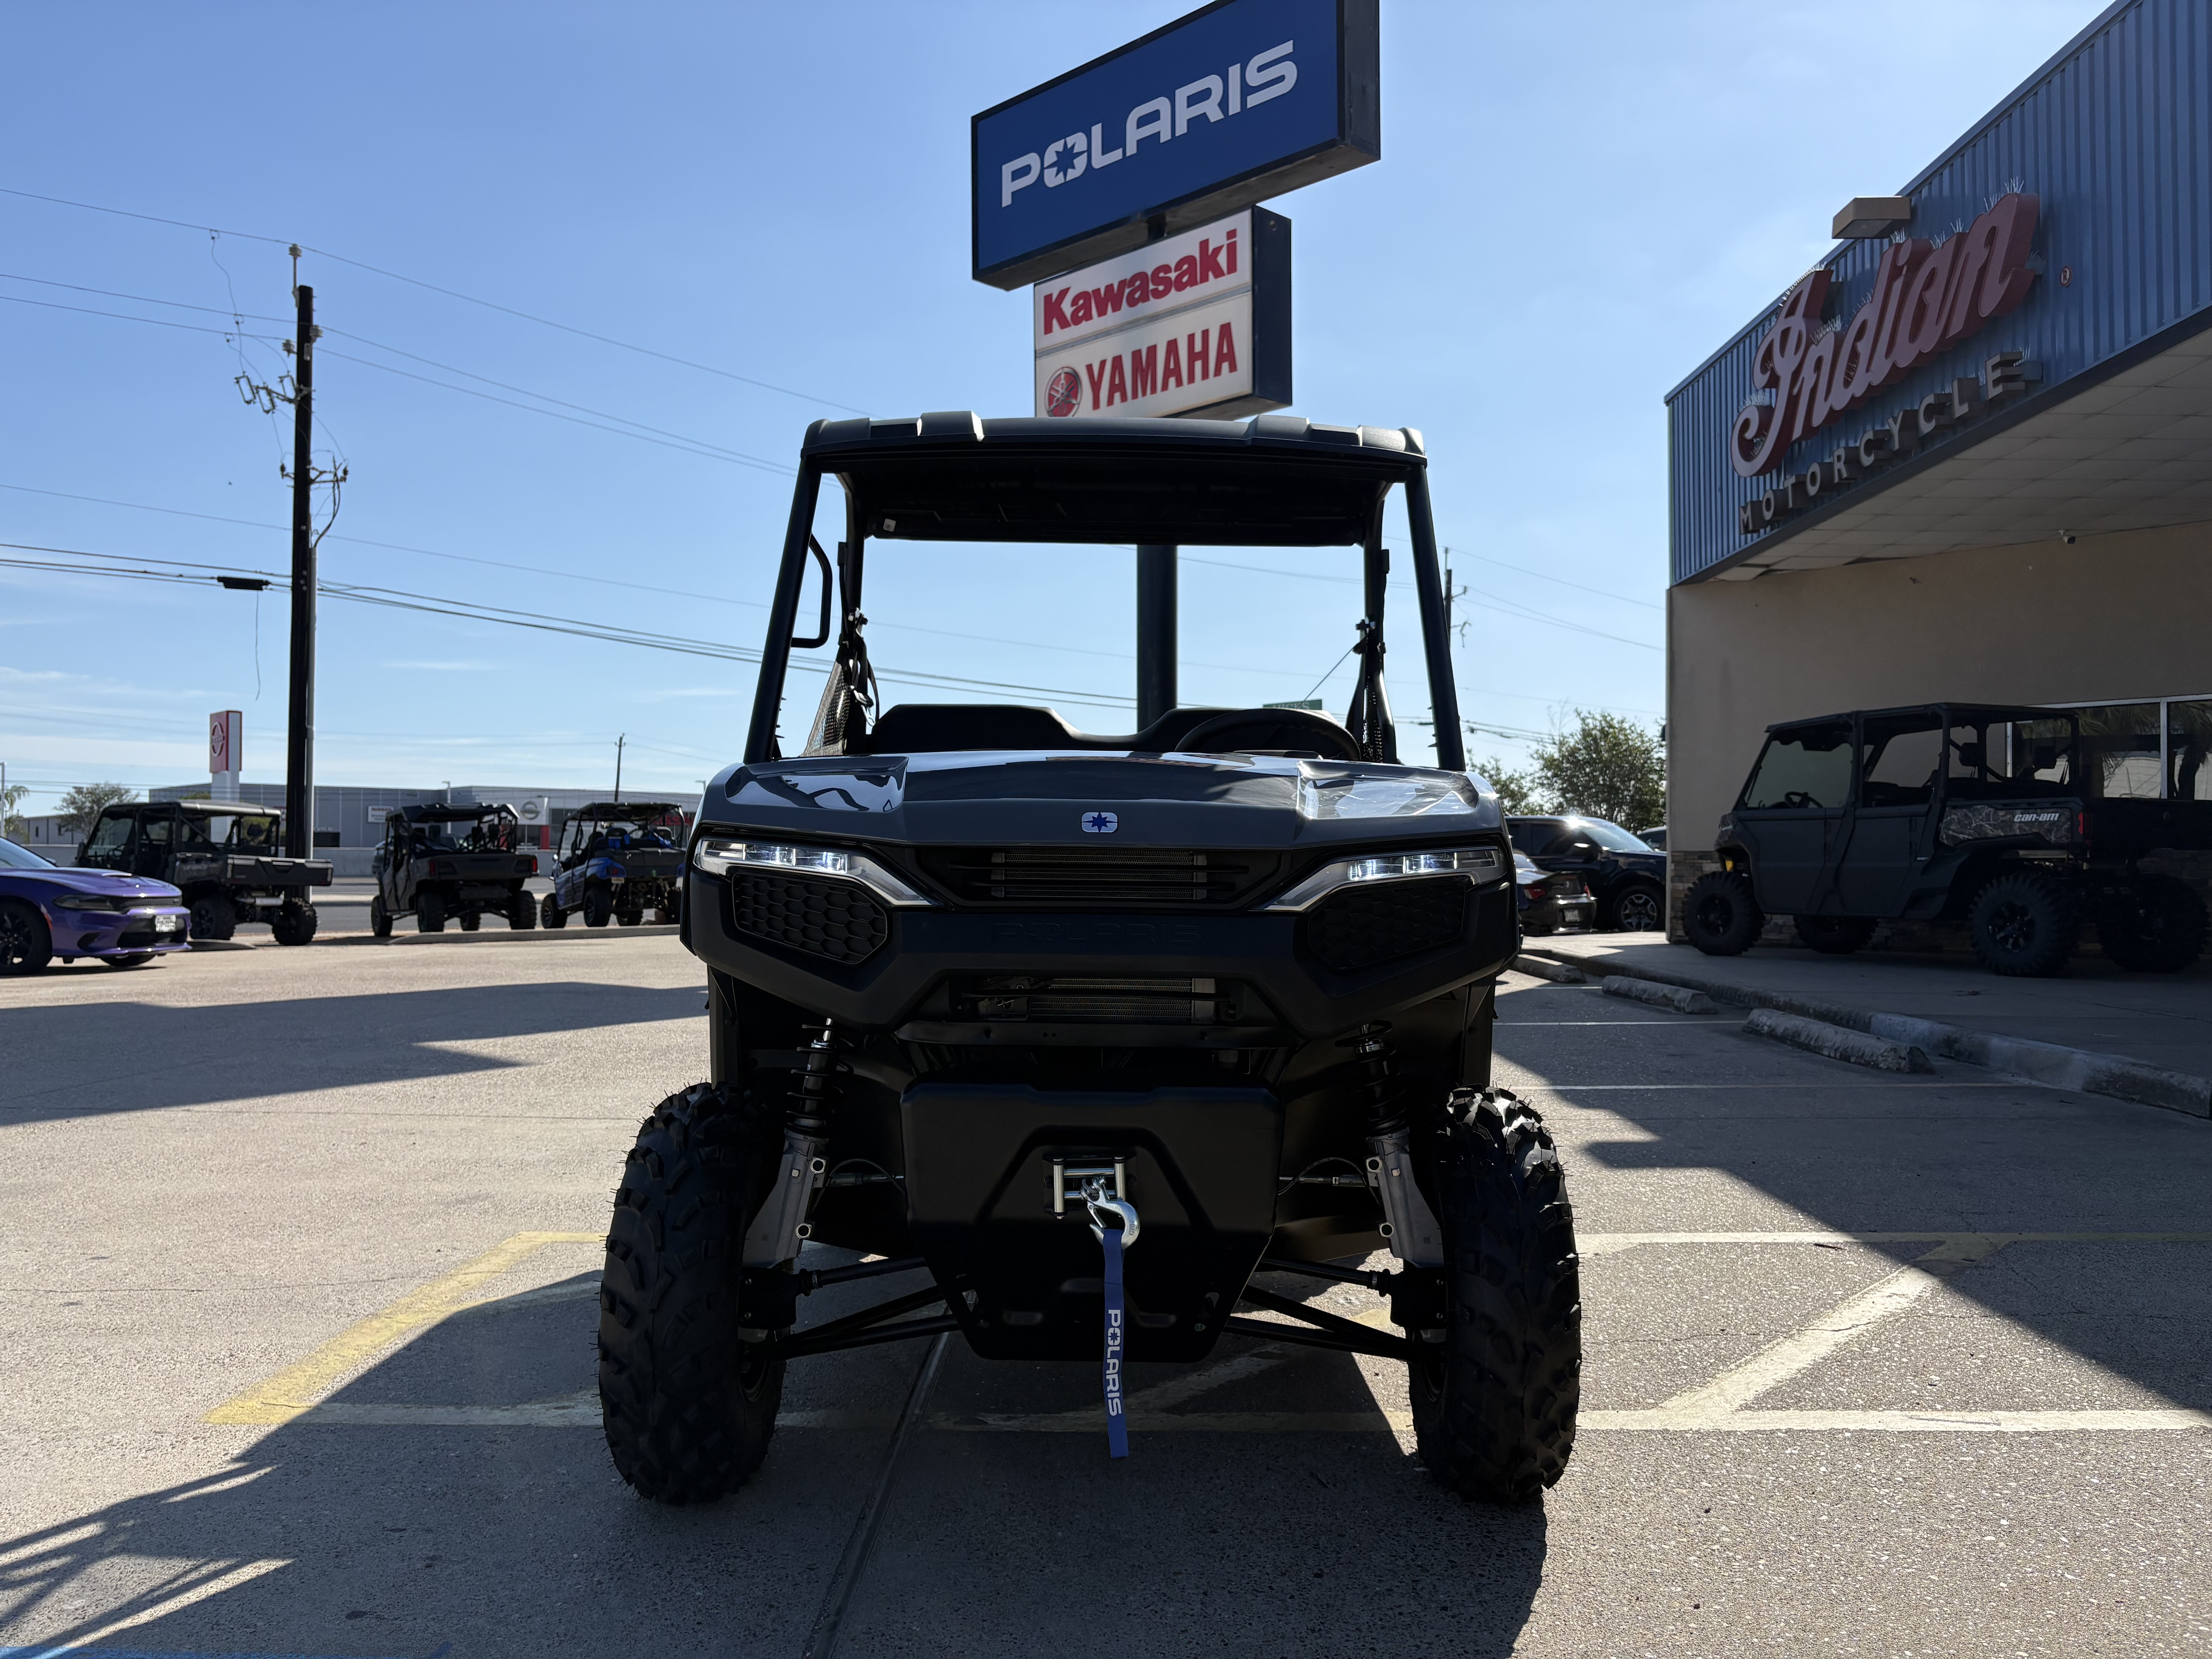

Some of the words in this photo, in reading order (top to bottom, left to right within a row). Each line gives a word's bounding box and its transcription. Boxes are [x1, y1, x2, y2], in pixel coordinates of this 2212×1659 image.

[1001, 39, 1298, 208] POLARIS
[1043, 229, 1238, 335] Kawasaki
[1731, 192, 2040, 477] Indian
[1085, 322, 1238, 411] YAMAHA
[1740, 351, 2025, 535] MOTORCYCLE
[2013, 813, 2059, 823] can-am
[991, 922, 1202, 945] POLARIS
[1106, 1309, 1122, 1417] POLARIS
